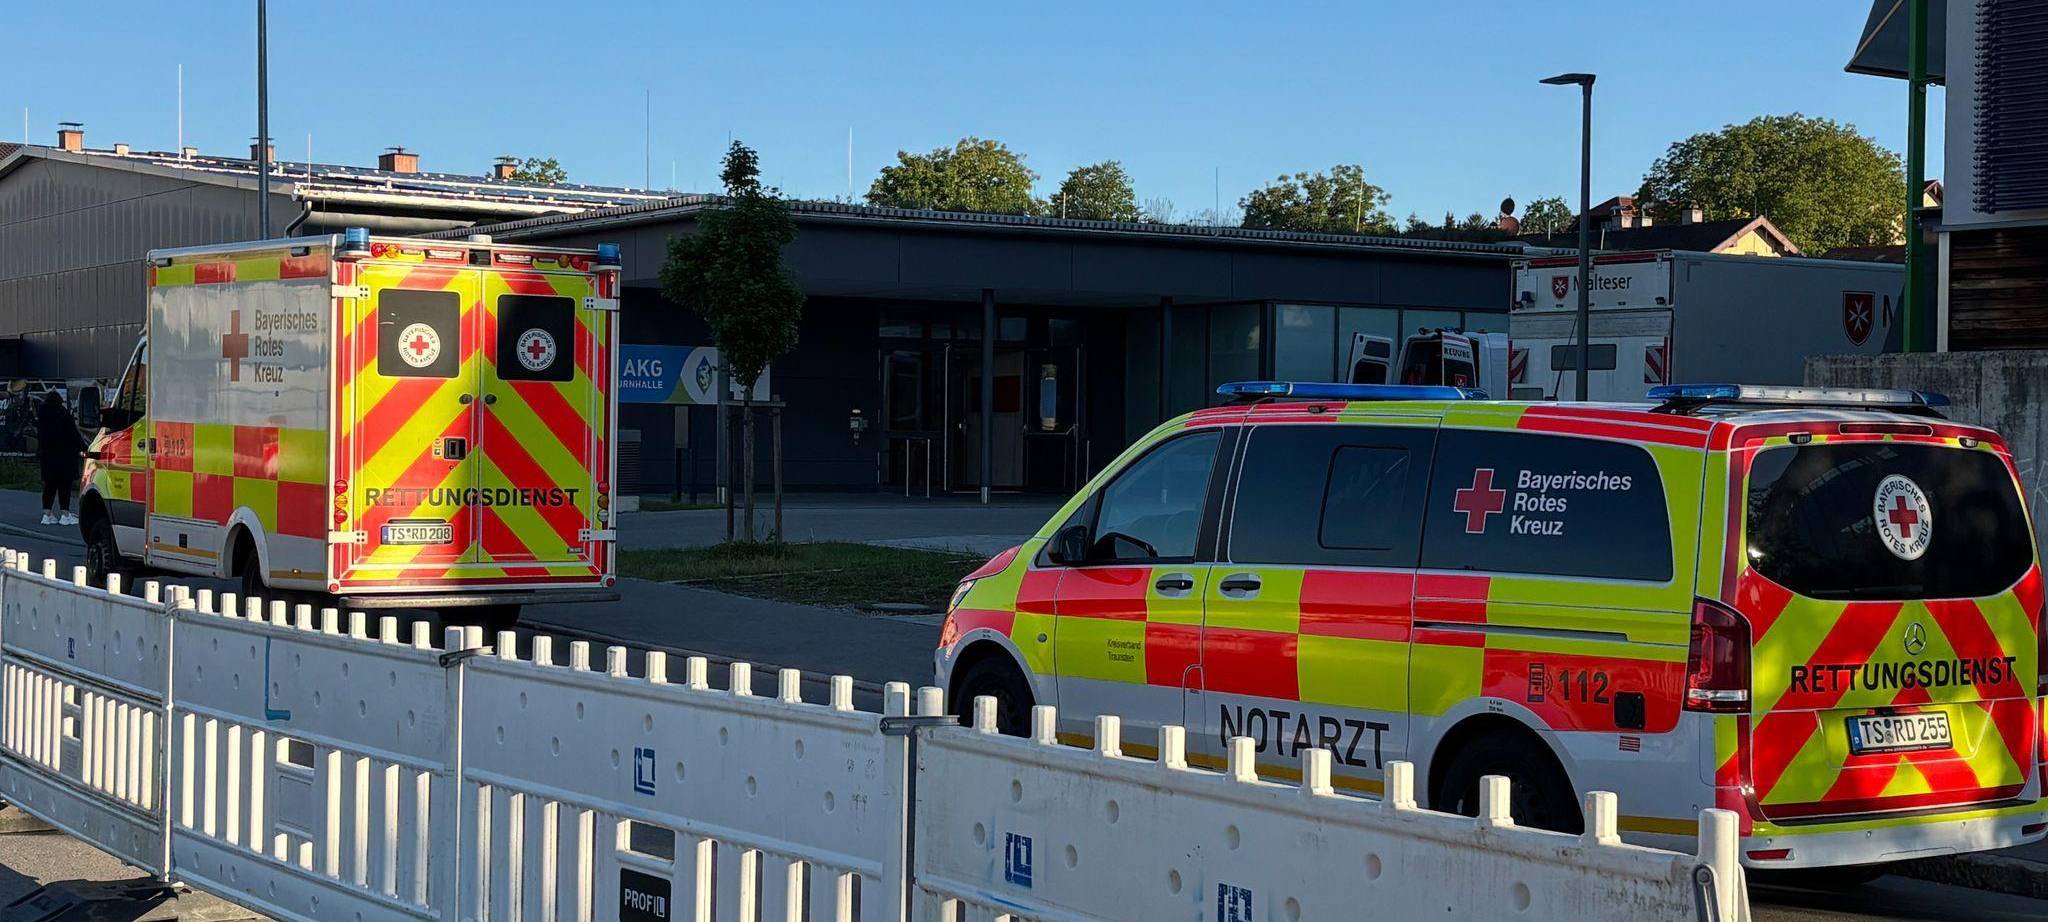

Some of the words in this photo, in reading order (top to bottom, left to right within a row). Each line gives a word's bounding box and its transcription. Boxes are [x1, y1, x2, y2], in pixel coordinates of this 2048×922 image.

[255, 307, 318, 335] Bayerisches
[254, 335, 284, 357] Rotes
[254, 361, 284, 383] Kreuz
[623, 359, 663, 377] AKG
[618, 379, 663, 389] URNHALLE
[1517, 470, 1632, 493] Bayerisches
[365, 487, 579, 507] RETTUNGSDIENST
[1513, 492, 1567, 513] Rotes
[1877, 480, 1926, 513] BAYERISCHES
[390, 528, 405, 540] TS
[412, 528, 427, 540] RD
[1510, 515, 1564, 535] Kreuz
[1880, 518, 1906, 553] ROTES
[1909, 518, 1929, 553] KREUZ
[1791, 656, 2017, 693] RETTUNGSDIENST
[1558, 669, 1610, 704] 112
[1220, 704, 1390, 769] NOTARZT
[1860, 720, 1885, 744] TS
[1894, 718, 1916, 743] RD
[1918, 717, 1948, 742] 255
[624, 888, 665, 918] PROFIL
